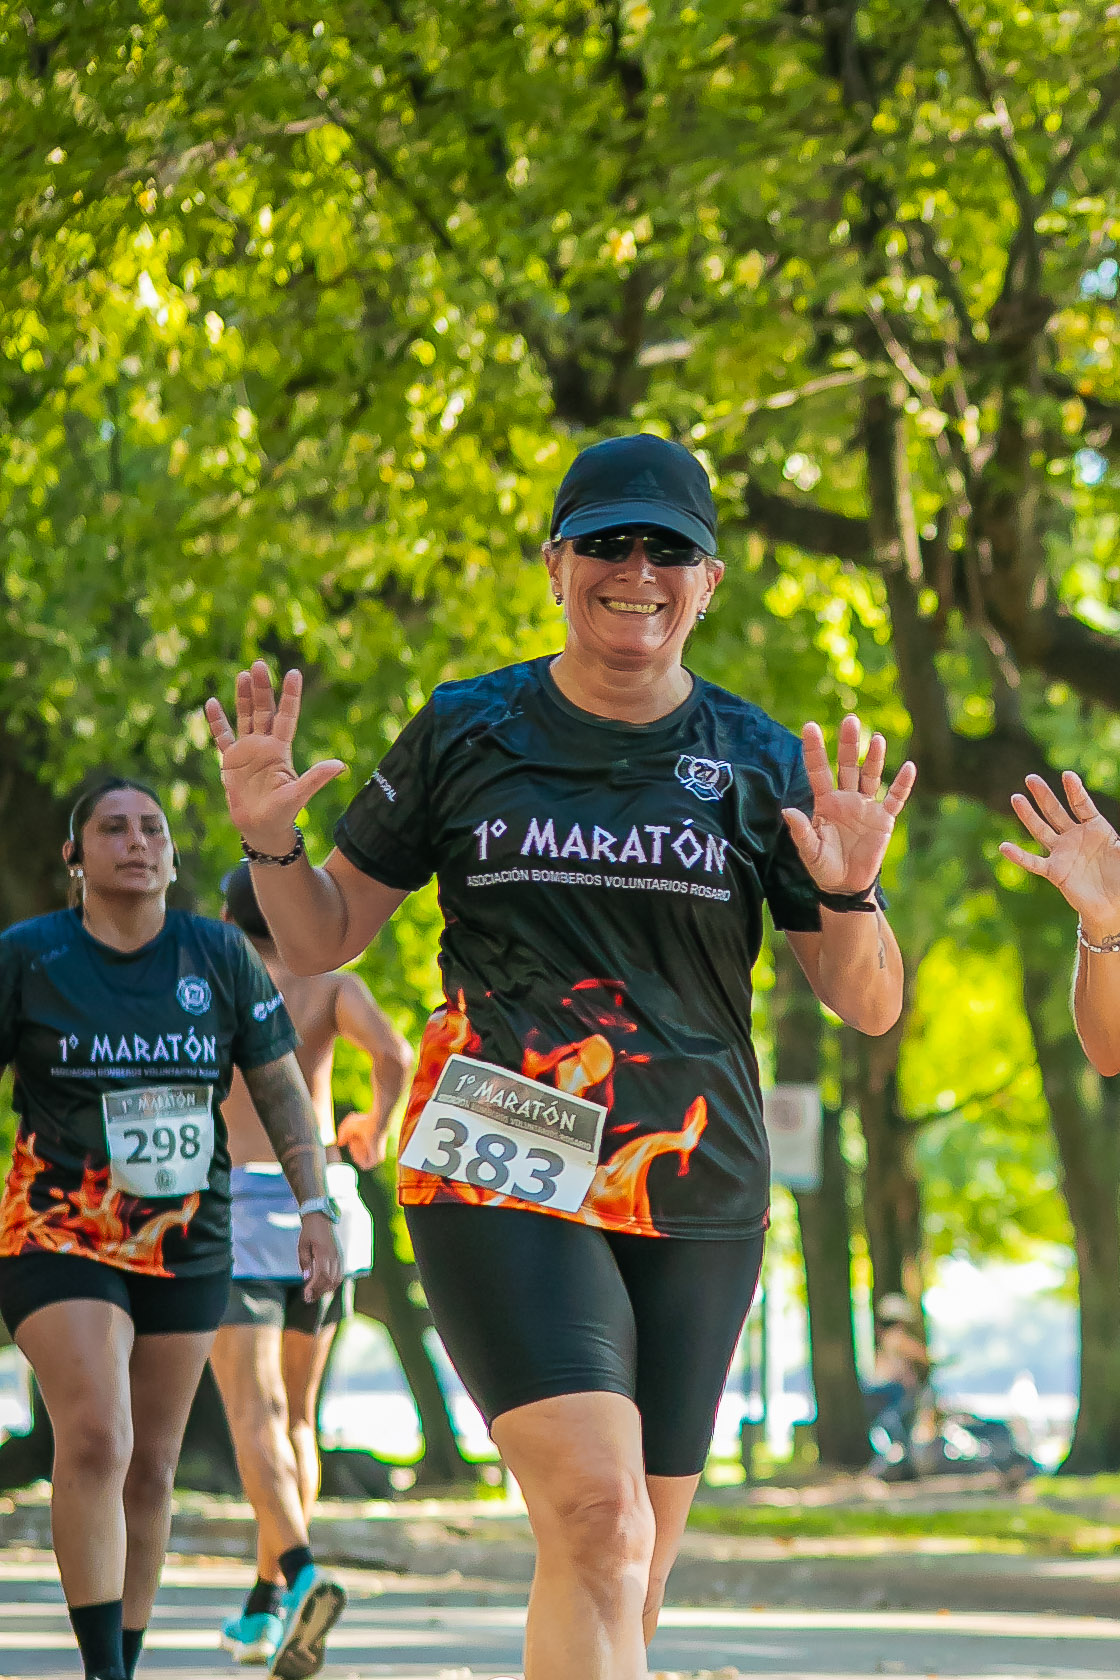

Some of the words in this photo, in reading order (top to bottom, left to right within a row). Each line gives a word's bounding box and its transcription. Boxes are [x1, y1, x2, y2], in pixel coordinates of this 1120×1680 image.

[520, 817, 729, 875] MARATÓN
[466, 867, 529, 887] ASOCIACIÓN
[531, 869, 601, 887] BOMBEROS
[604, 875, 688, 894] VOLUNTARIOS
[90, 1025, 217, 1063] MARATÓN
[473, 1081, 577, 1132] MARATÓN
[123, 1123, 200, 1165] 298
[421, 1117, 565, 1203] 383
